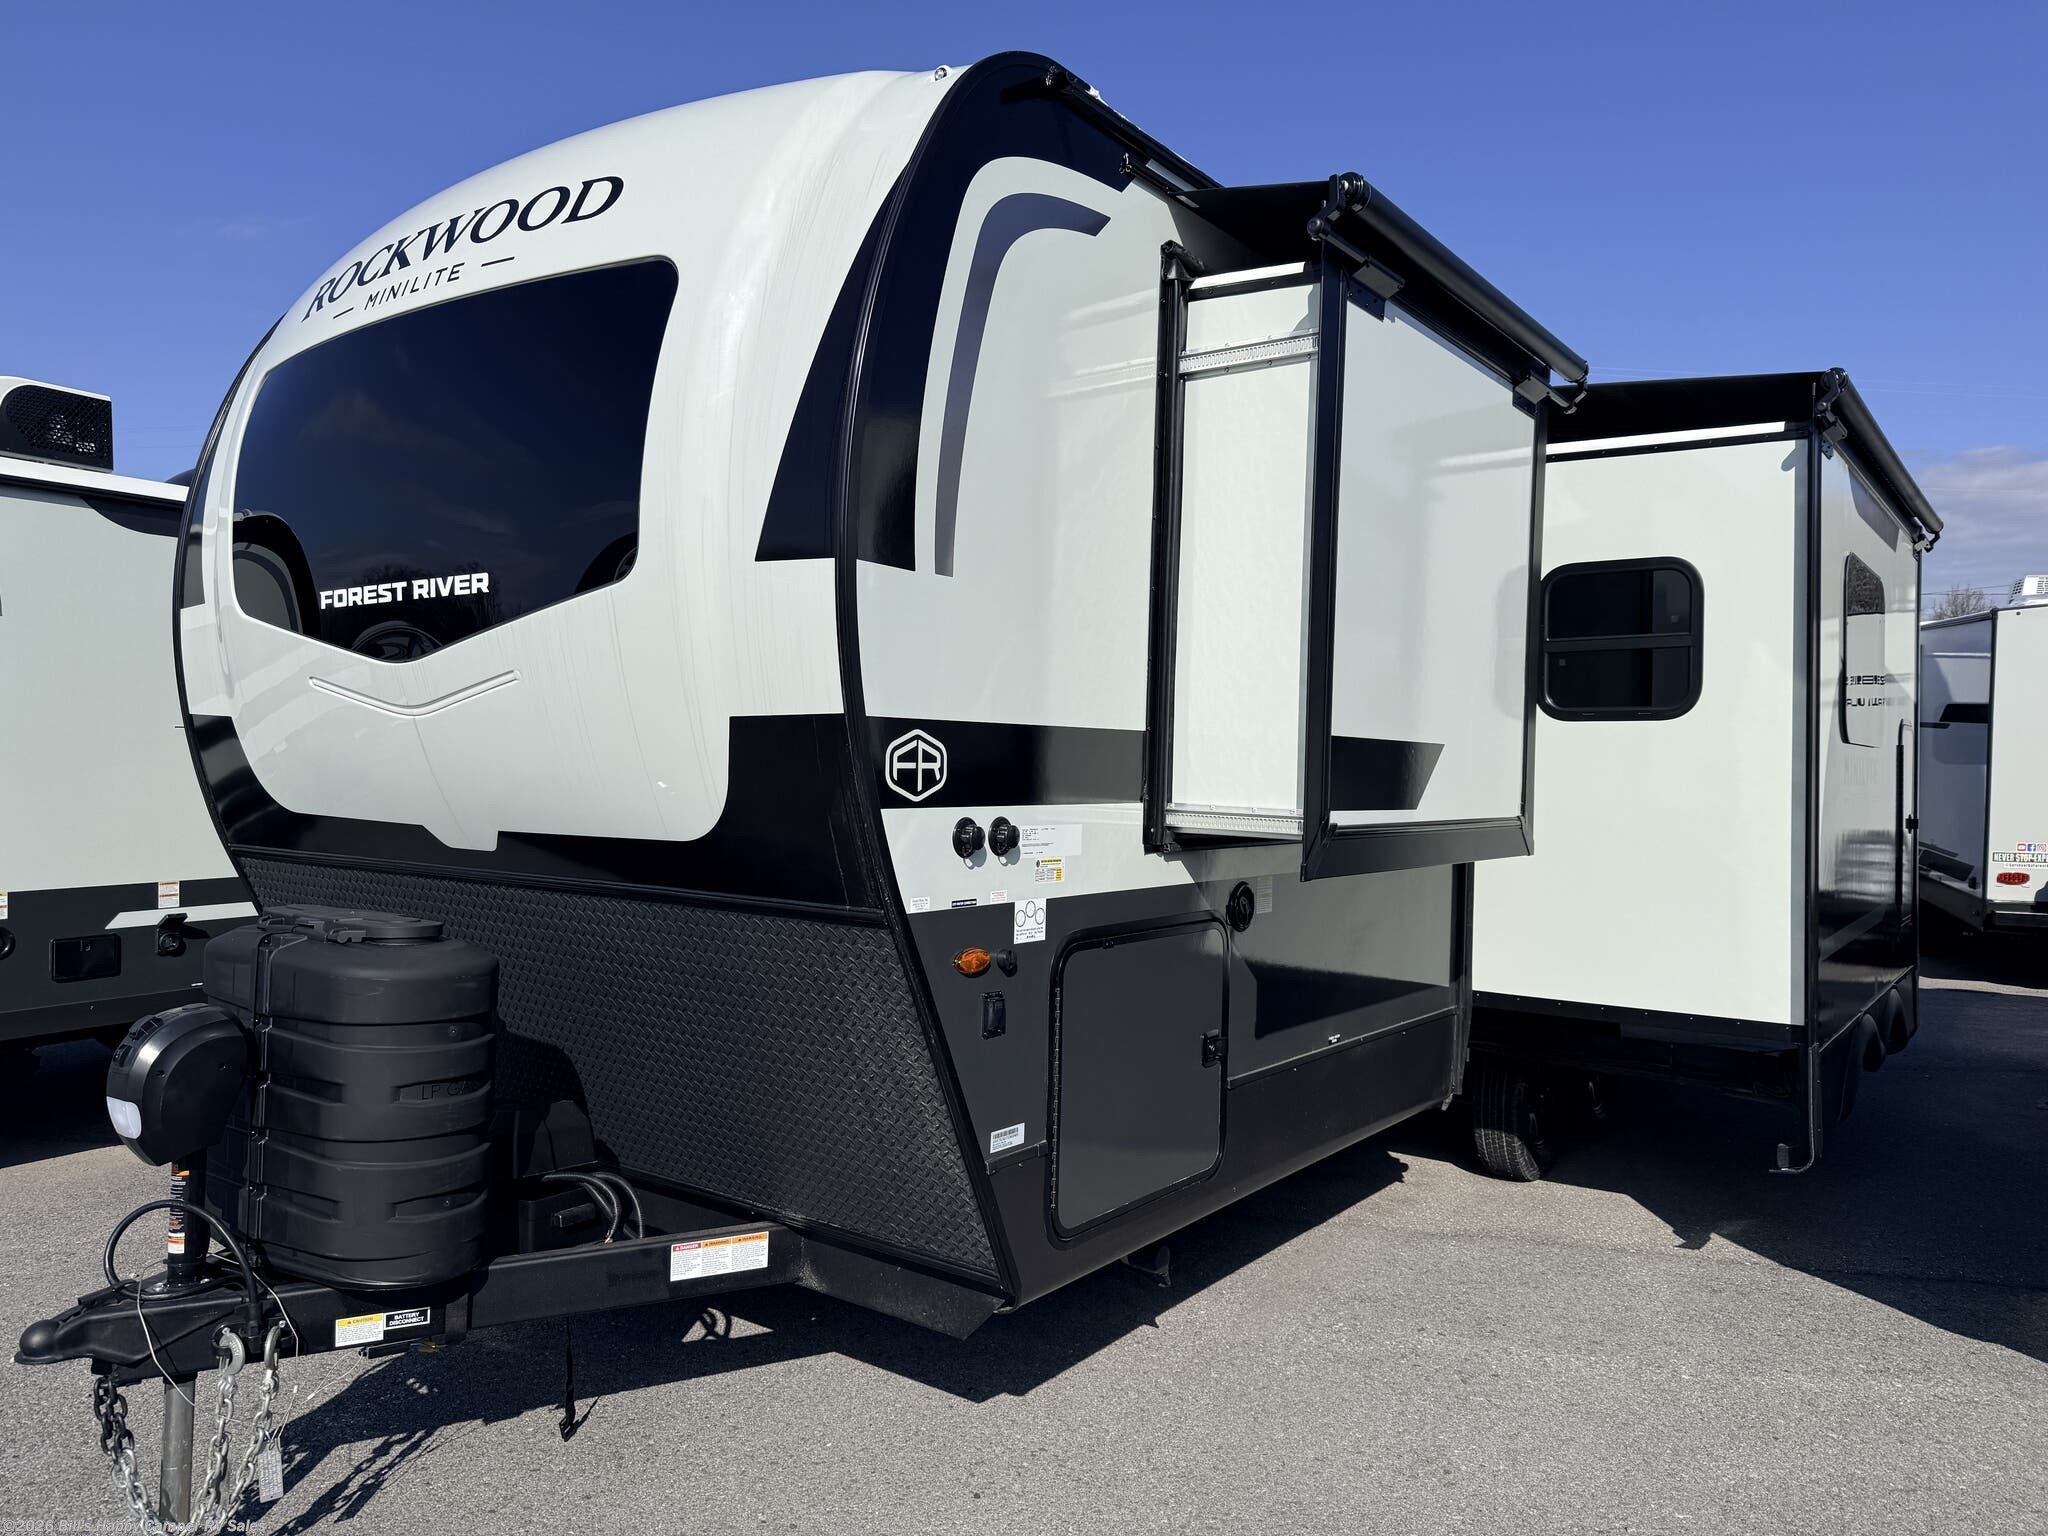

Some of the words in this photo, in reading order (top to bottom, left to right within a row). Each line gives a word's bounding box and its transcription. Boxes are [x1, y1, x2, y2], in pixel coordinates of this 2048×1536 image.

[300, 175, 625, 322] ROCKWOOD
[364, 262, 466, 311] MINILITE
[320, 581, 409, 610] FOREST
[412, 571, 490, 601] RIVER
[1994, 853, 2015, 862] NEVER
[679, 1243, 699, 1251] DANGER
[389, 1316, 424, 1326] DISCONNECT
[394, 1312, 420, 1320] BATTERY
